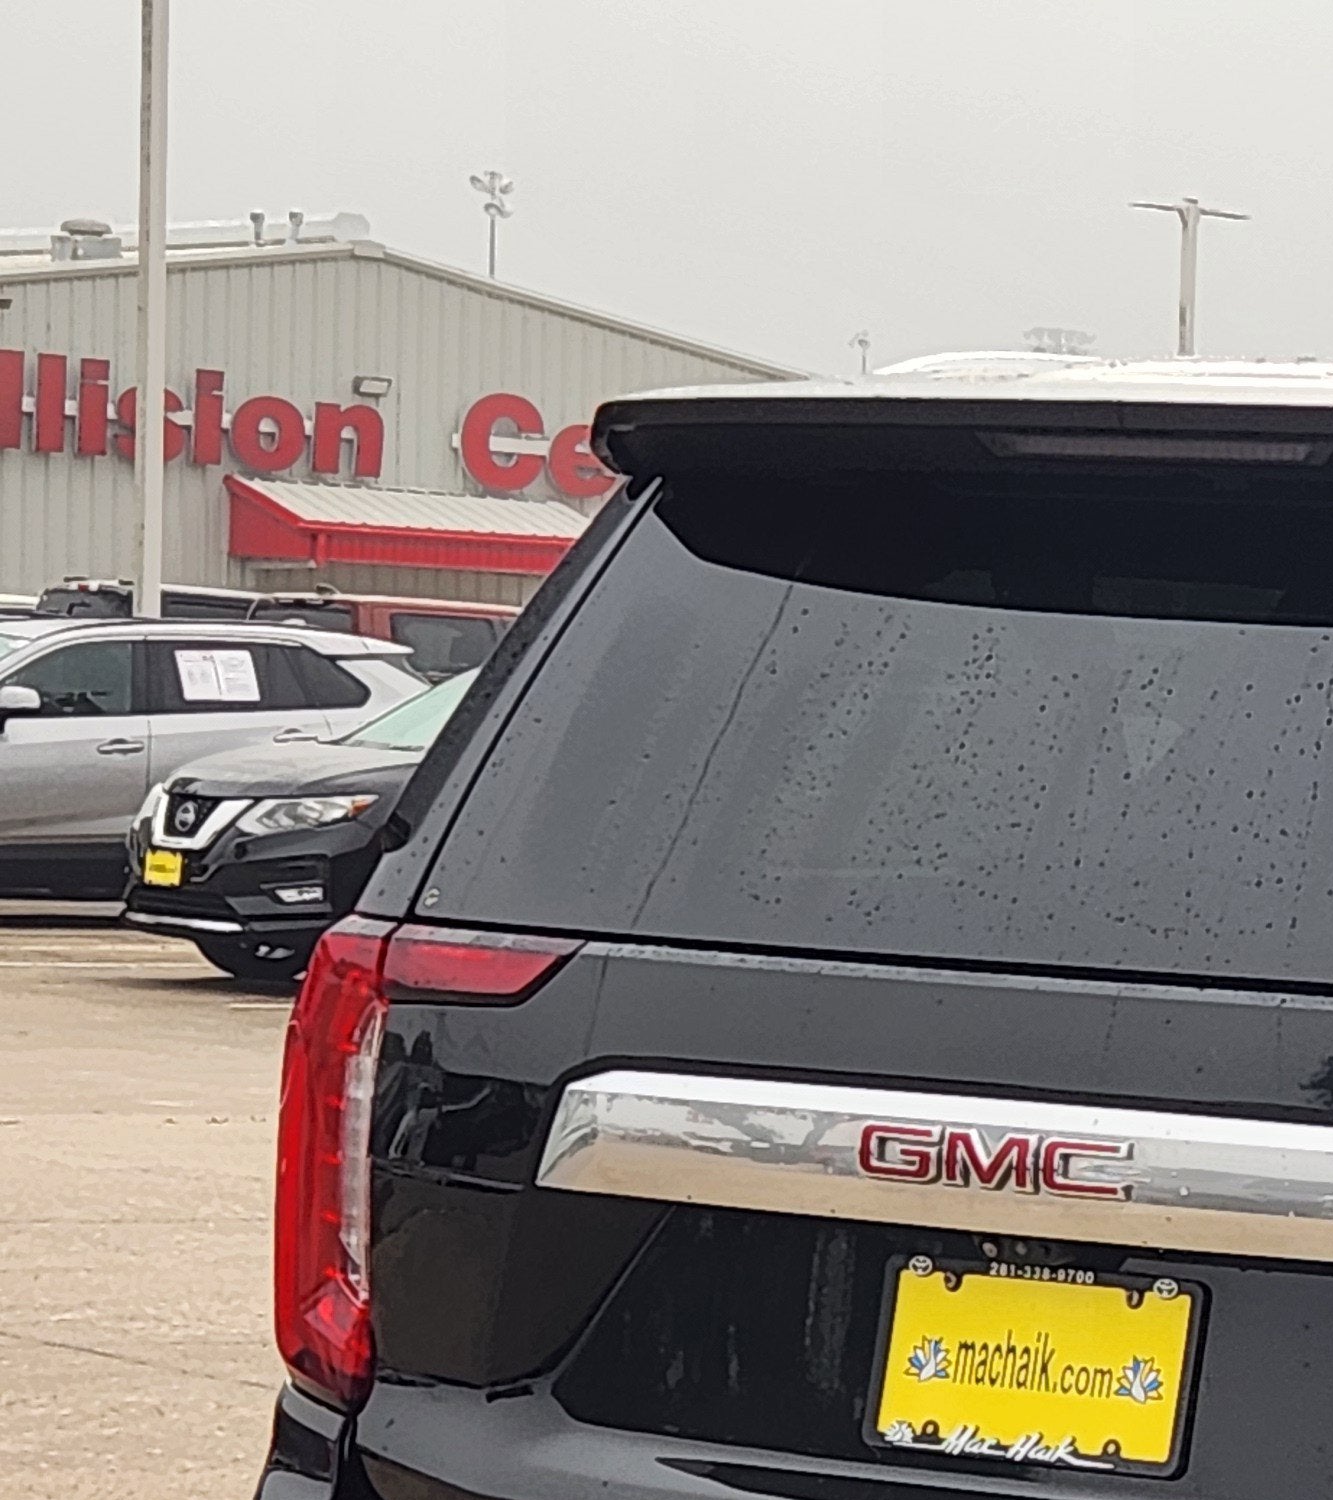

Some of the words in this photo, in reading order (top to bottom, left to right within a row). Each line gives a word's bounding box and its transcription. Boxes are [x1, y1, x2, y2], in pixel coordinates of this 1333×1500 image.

[859, 1123, 1133, 1201] GMC
[989, 1261, 1095, 1284] 281-338-9700
[952, 1328, 1114, 1399] machaik.com
